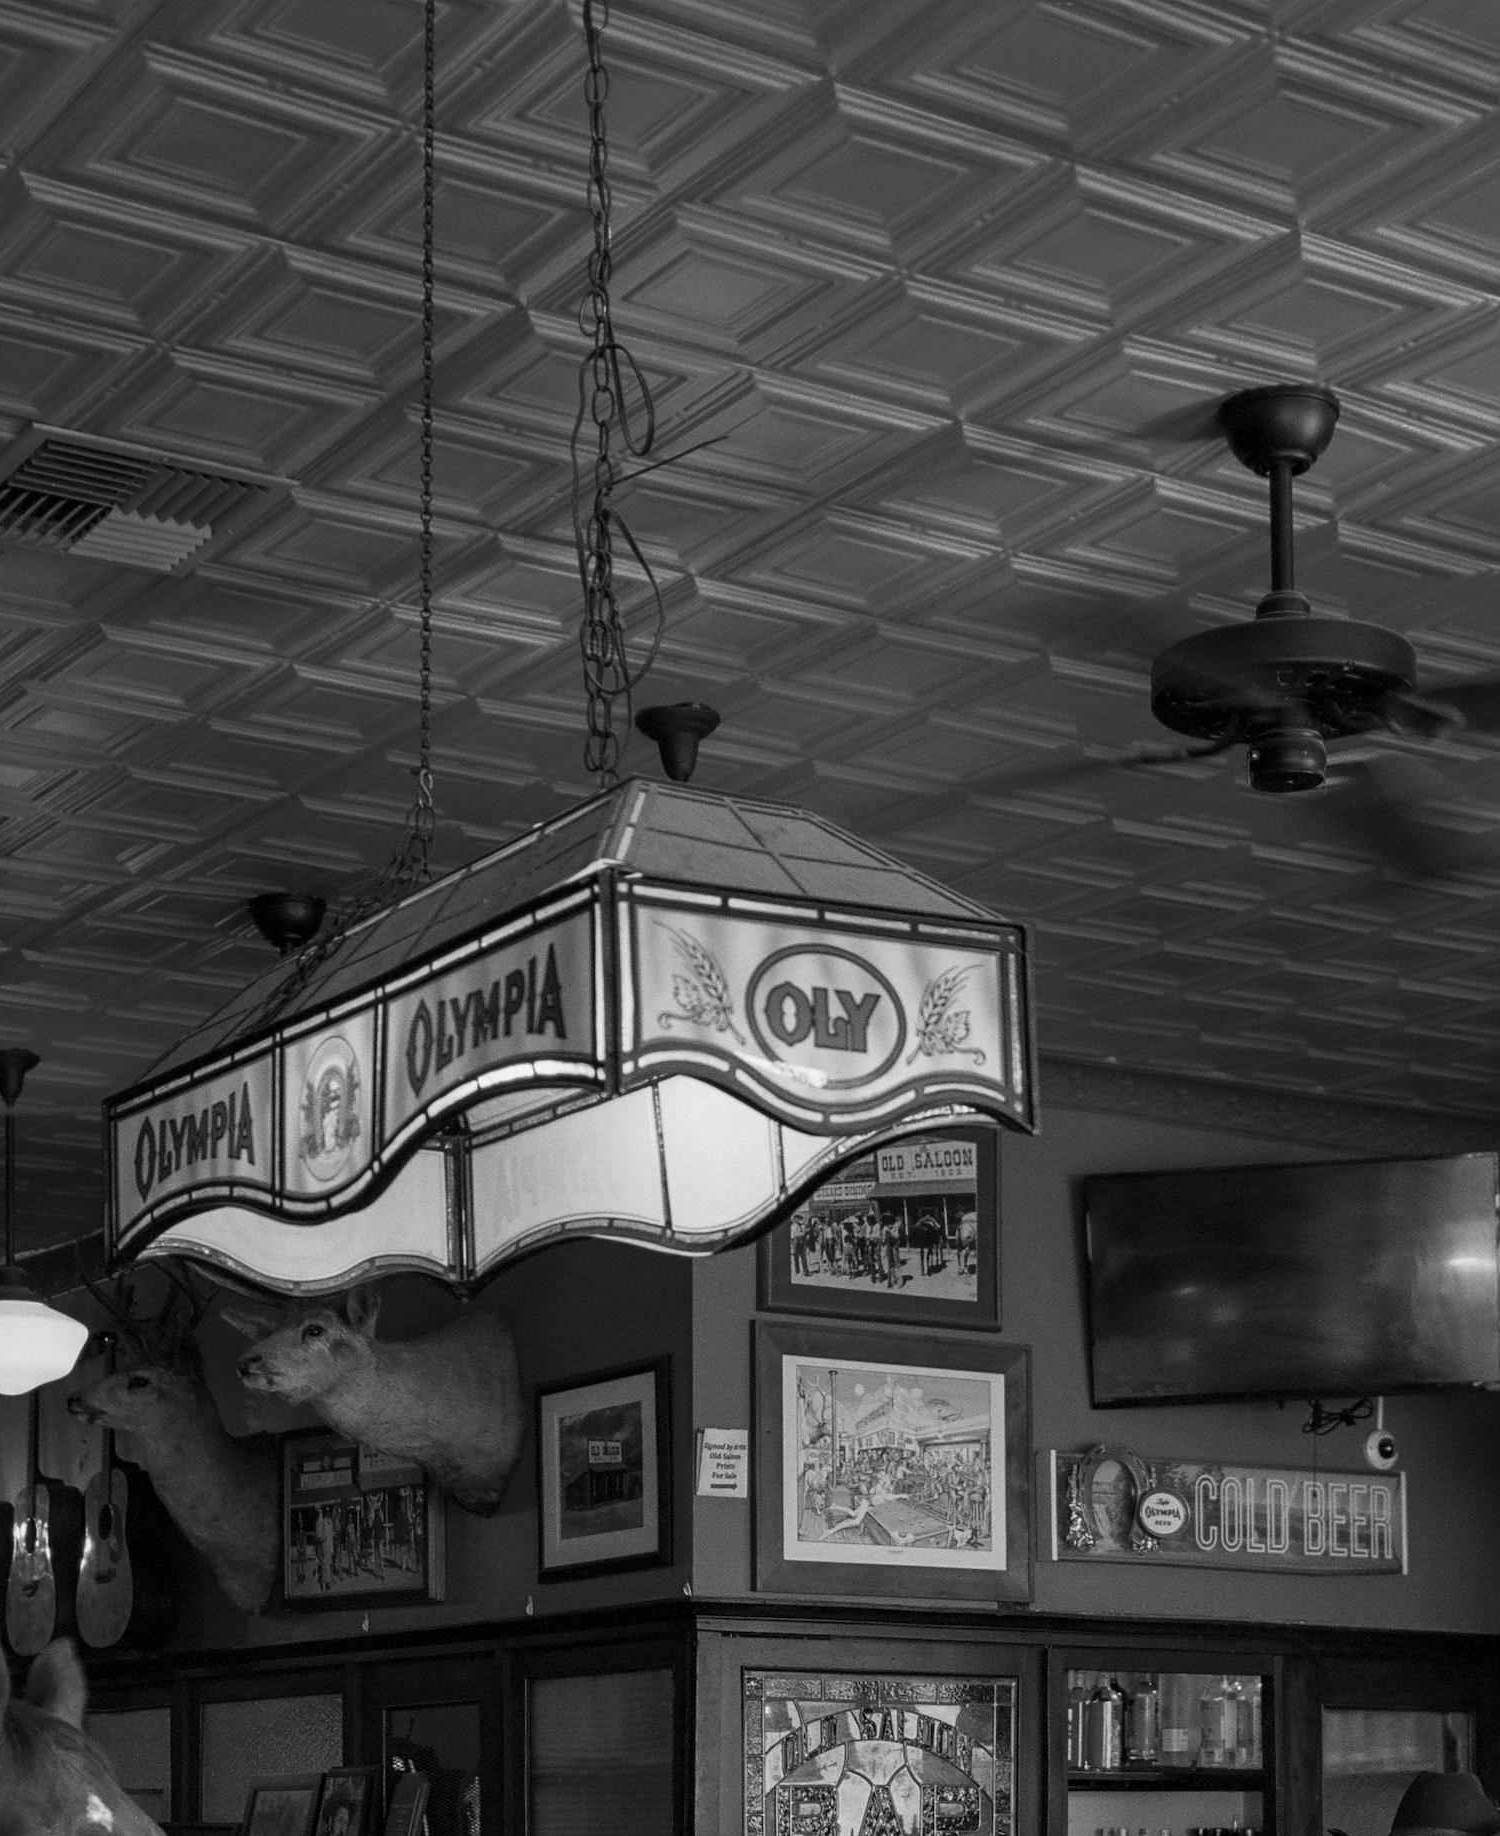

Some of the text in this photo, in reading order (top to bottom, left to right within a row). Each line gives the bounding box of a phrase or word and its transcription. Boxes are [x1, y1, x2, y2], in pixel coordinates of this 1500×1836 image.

[405, 942, 567, 1098] OLYMPIA
[765, 981, 881, 1053] OLY
[134, 1080, 256, 1202] OLYMPIA
[882, 1148, 973, 1172] OLD SALOON
[709, 1452, 721, 1460] Old
[716, 1462, 735, 1470] Prints
[712, 1471, 723, 1479] For
[1145, 1505, 1181, 1520] OLYMPIA
[1195, 1474, 1393, 1560] COLD BEER
